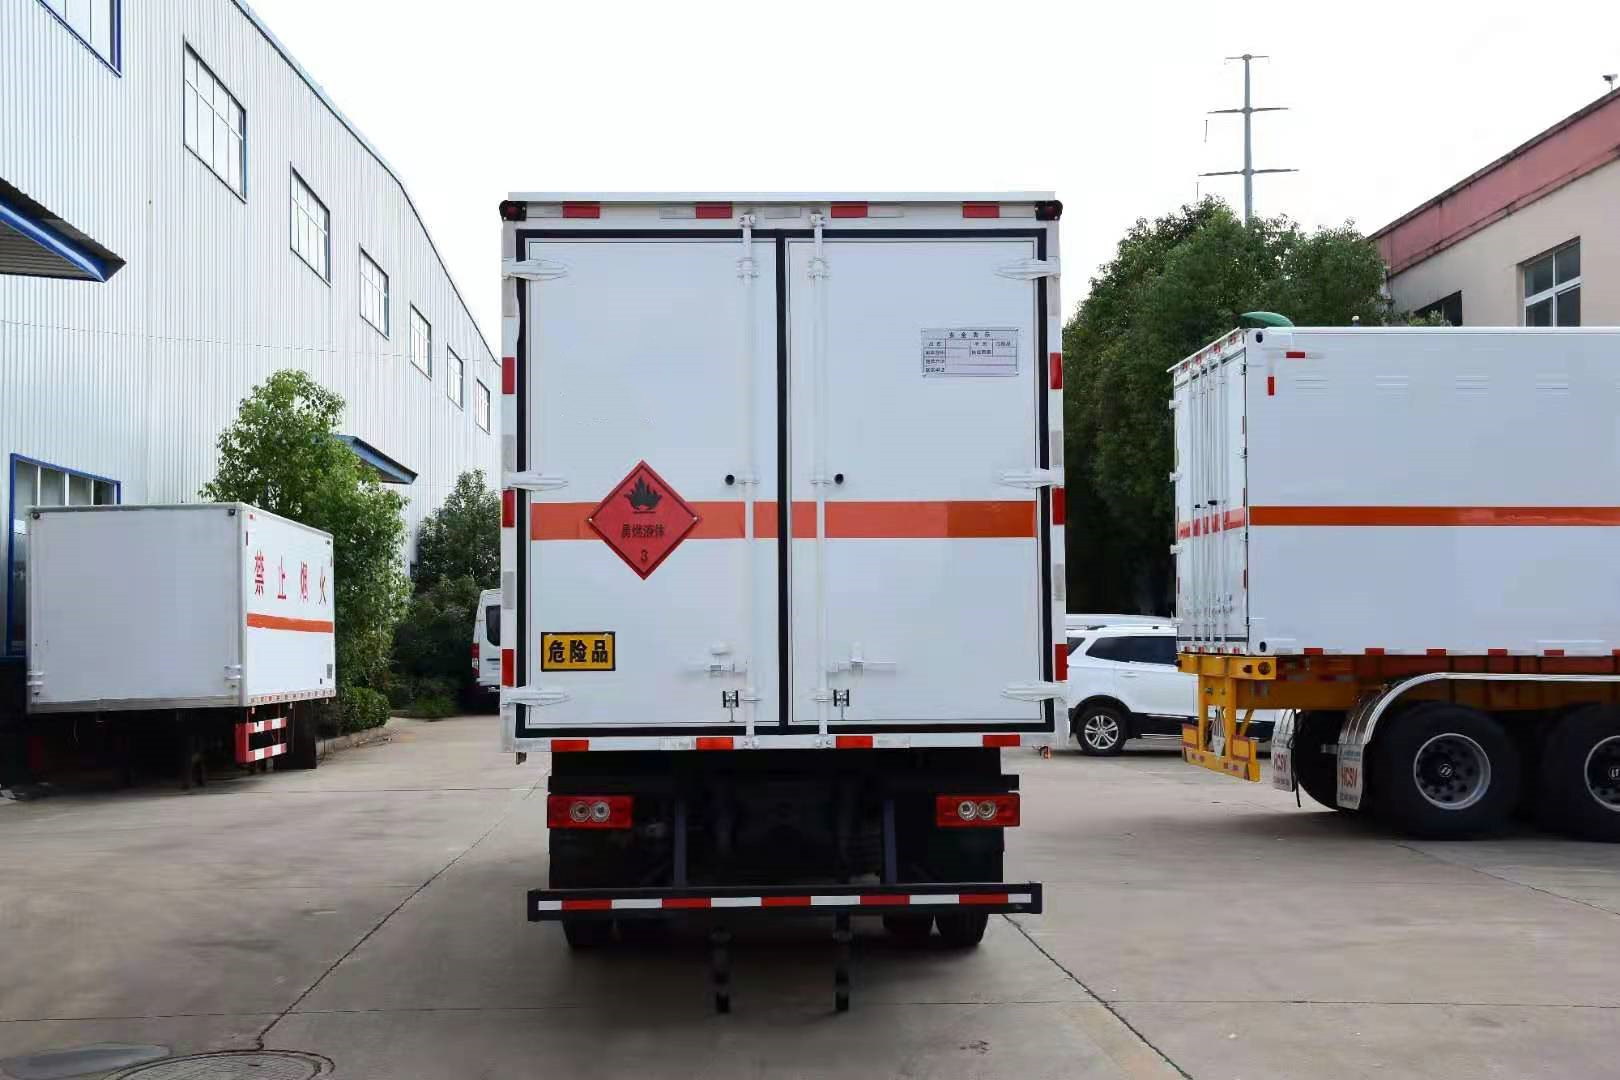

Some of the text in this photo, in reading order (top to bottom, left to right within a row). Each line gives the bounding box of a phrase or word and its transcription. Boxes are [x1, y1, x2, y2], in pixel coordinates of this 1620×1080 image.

[640, 549, 648, 562] 3
[547, 639, 609, 664] 危险品
